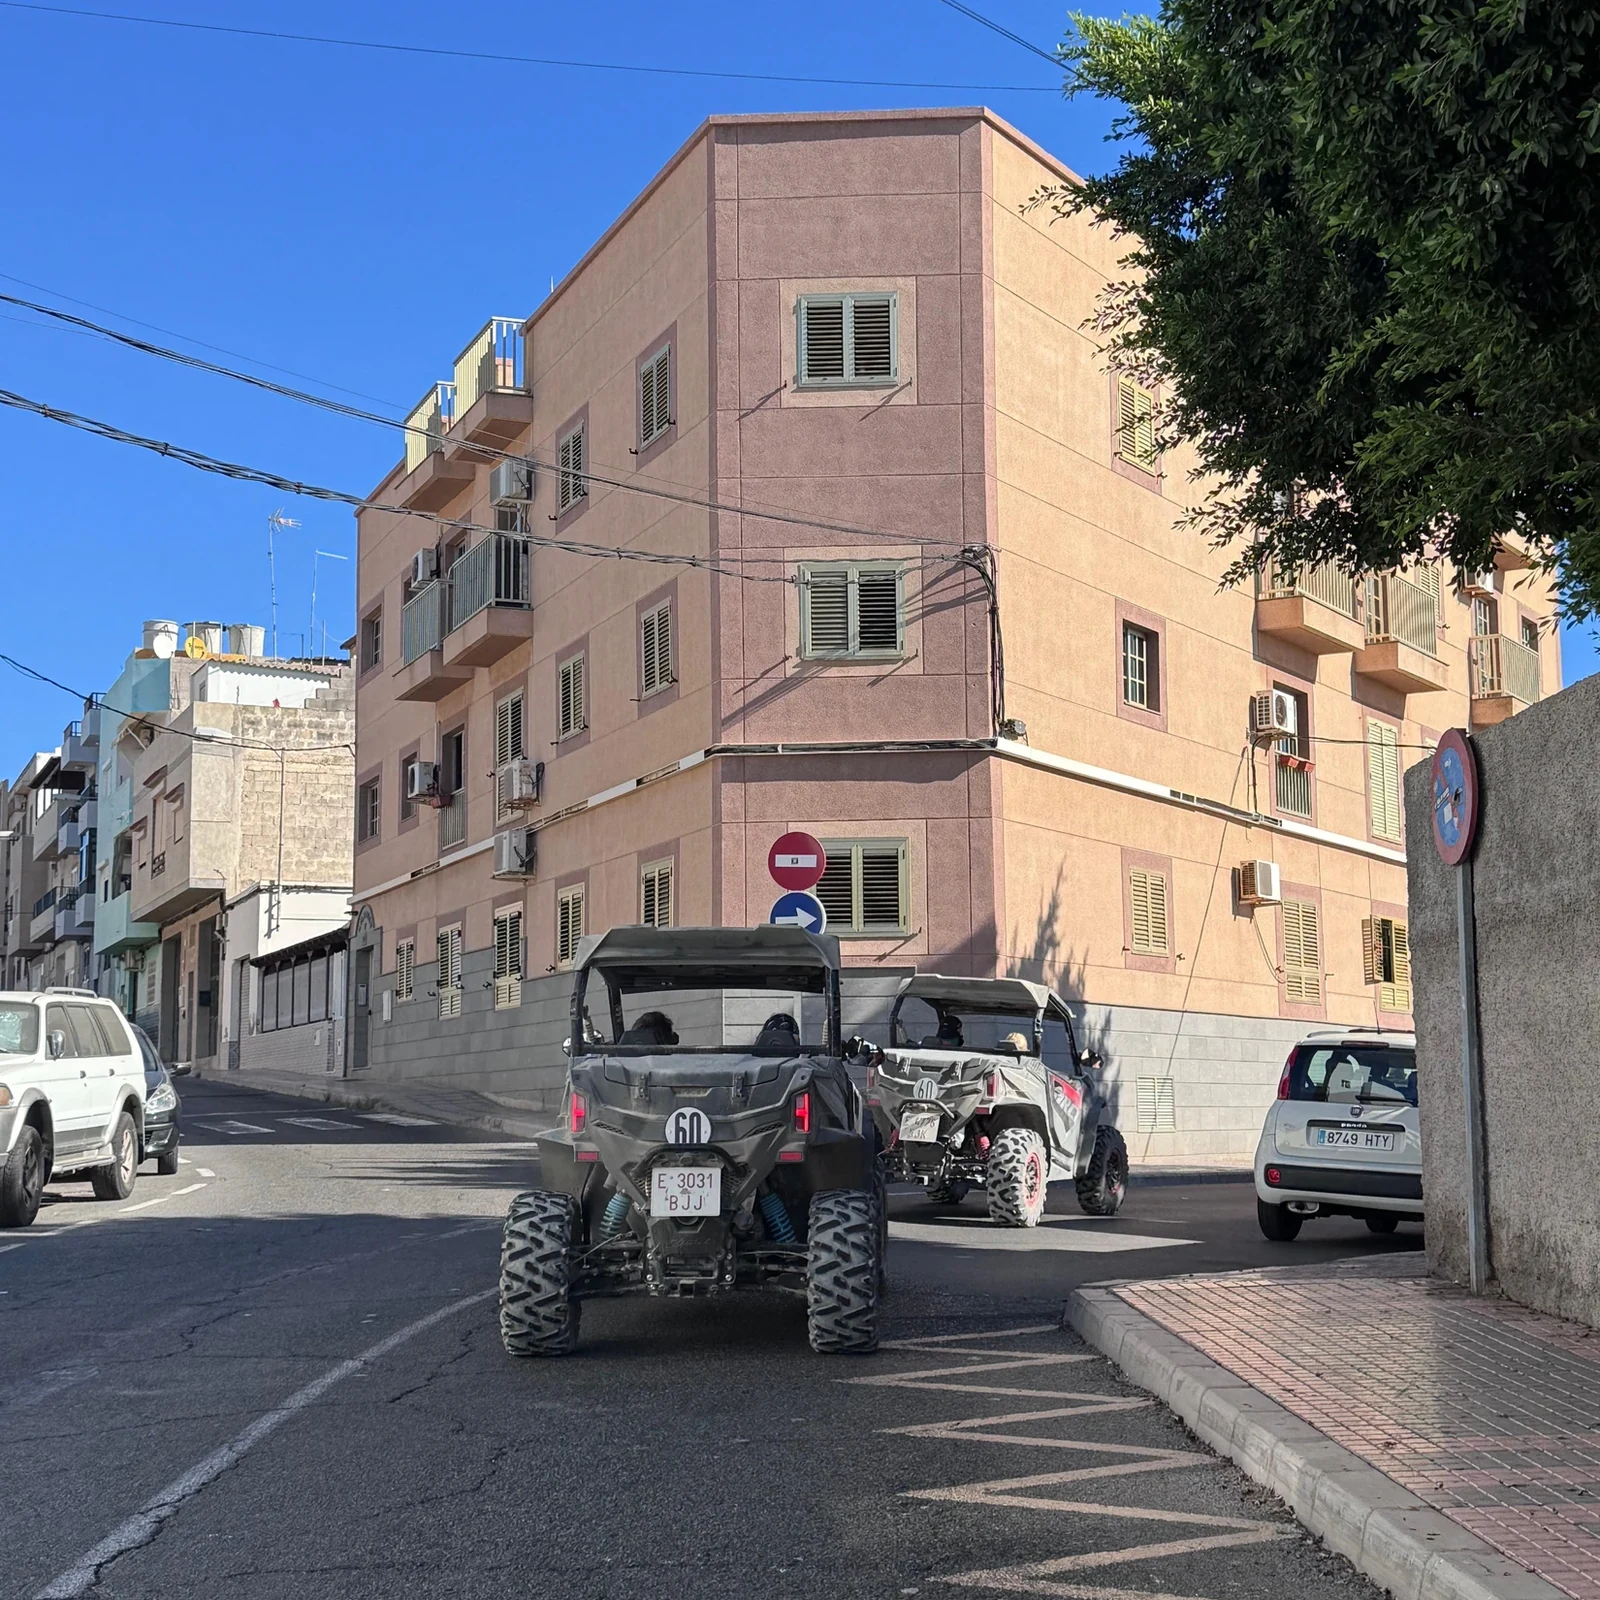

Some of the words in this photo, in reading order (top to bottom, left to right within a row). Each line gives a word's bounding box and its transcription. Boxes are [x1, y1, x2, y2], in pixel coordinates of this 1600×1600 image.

[918, 1080, 933, 1099] 60
[675, 1112, 701, 1144] 60
[1328, 1132, 1358, 1145] 8749
[1365, 1134, 1389, 1147] HTY
[658, 1173, 667, 1189] E
[677, 1173, 713, 1189] 3031
[669, 1195, 702, 1211] BJJ
